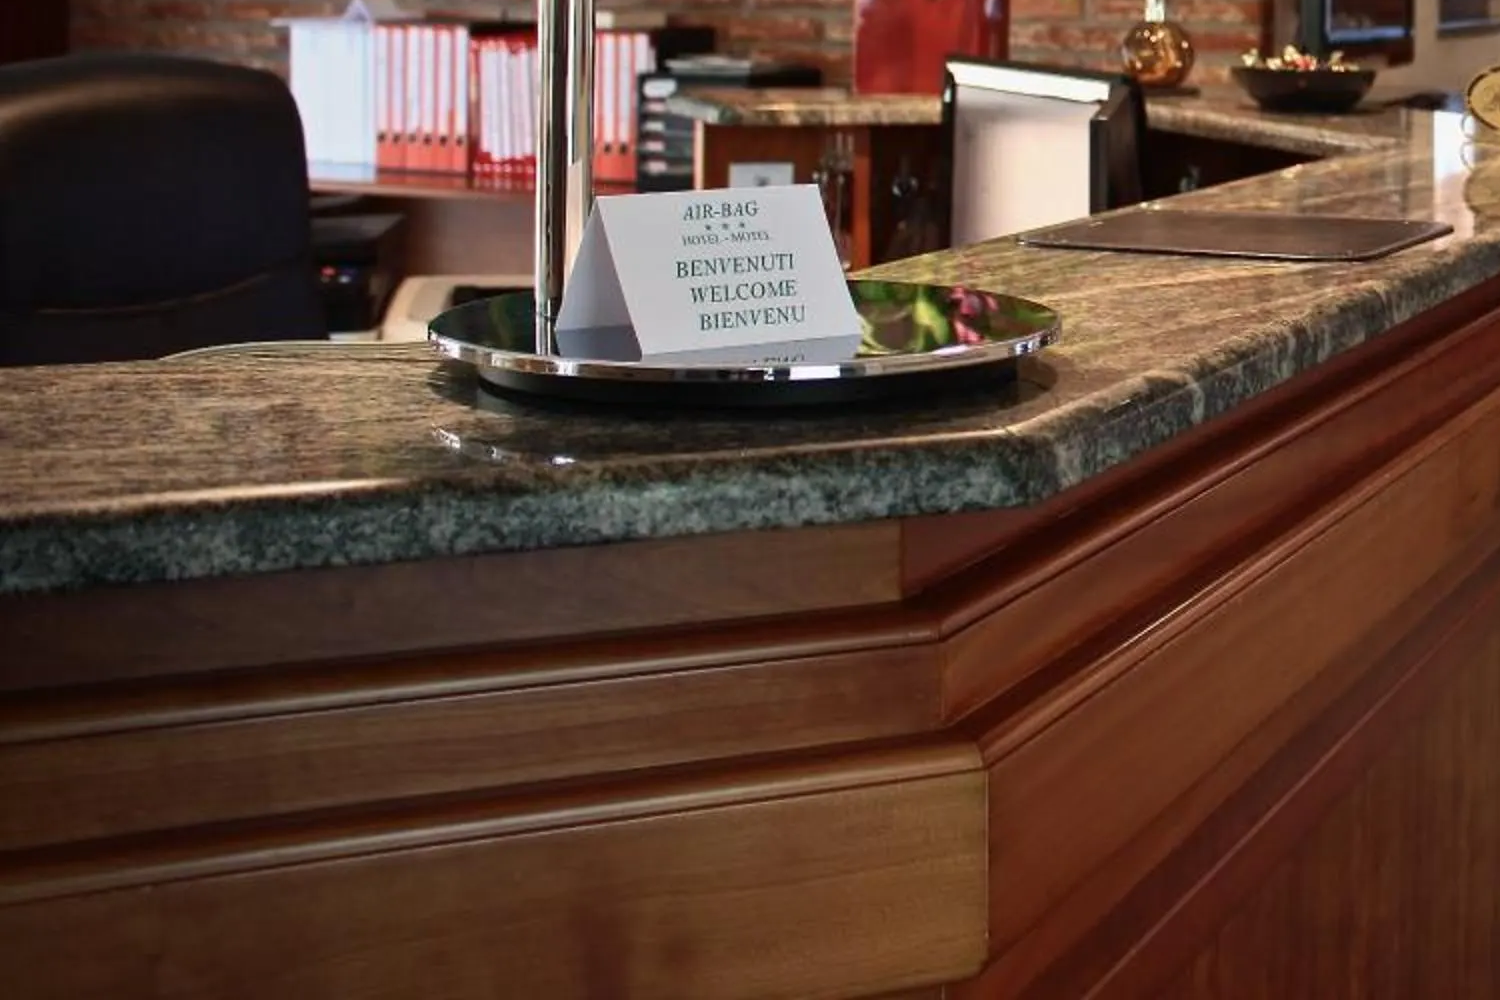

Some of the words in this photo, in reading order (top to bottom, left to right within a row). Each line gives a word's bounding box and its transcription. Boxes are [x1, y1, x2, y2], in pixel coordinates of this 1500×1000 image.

[683, 200, 760, 221] AIR-BAG
[676, 253, 795, 279] BENVENUTI
[691, 279, 798, 304] WELCOME
[700, 305, 806, 331] BIENVENU
